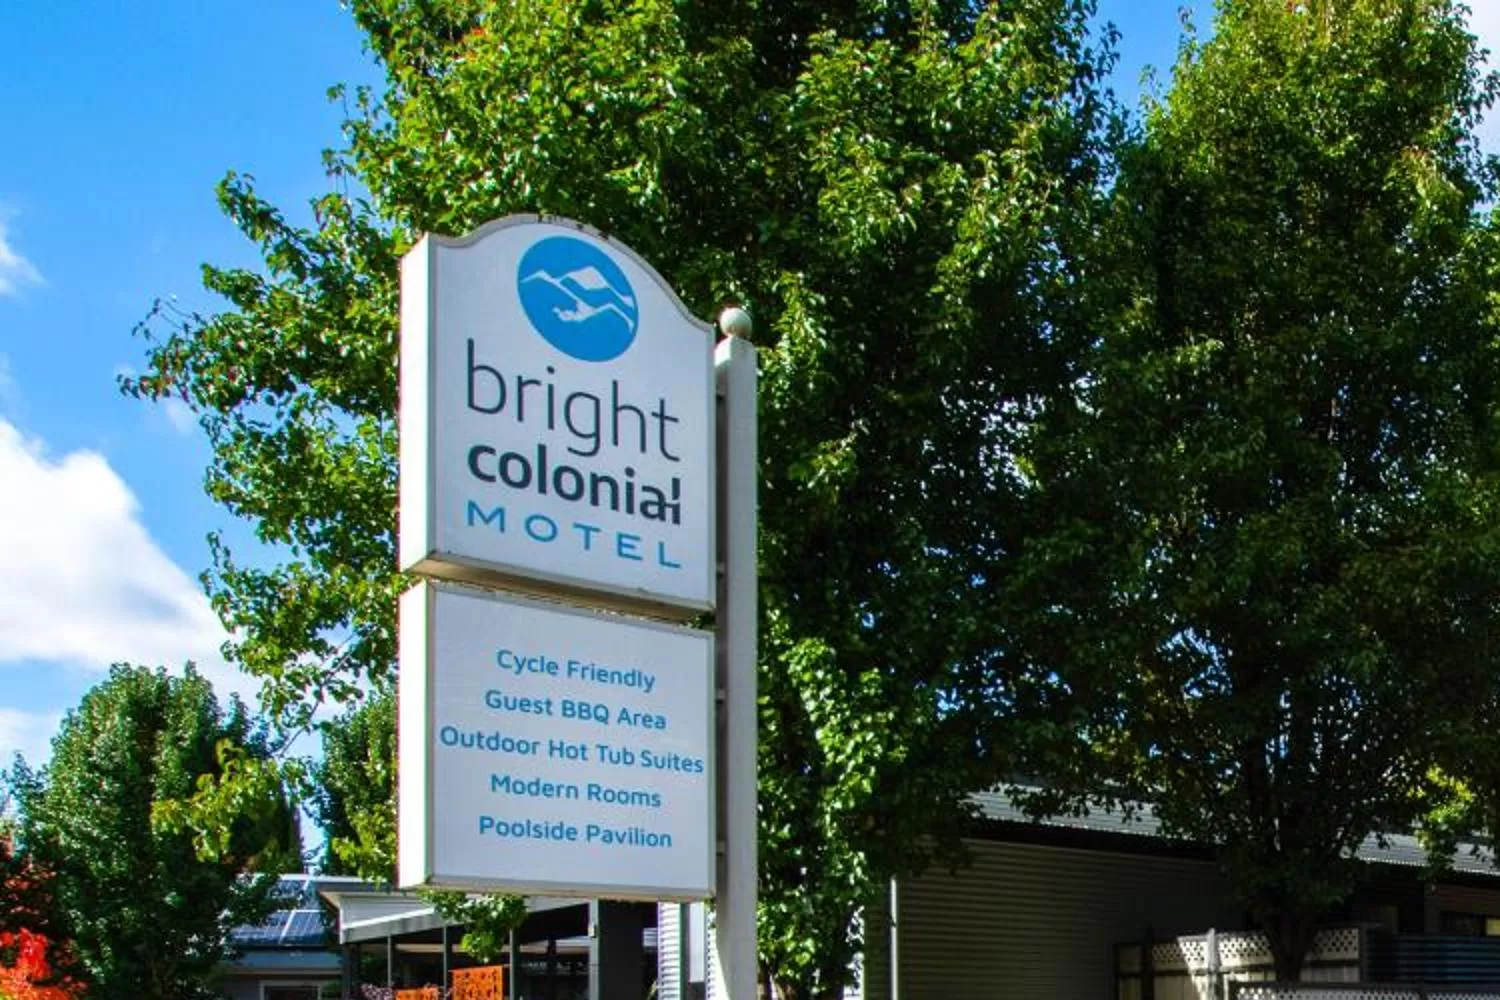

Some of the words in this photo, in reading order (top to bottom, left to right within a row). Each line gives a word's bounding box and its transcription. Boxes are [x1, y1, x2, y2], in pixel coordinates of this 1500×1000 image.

[466, 338, 681, 462] bright
[467, 443, 681, 526] colonial
[466, 500, 682, 569] MOTEL
[496, 649, 559, 676] Cycle
[567, 660, 656, 693] Friendly
[485, 689, 553, 717] Guest
[561, 699, 609, 725] BBQ
[617, 708, 667, 730] Area
[440, 726, 541, 756] Outdoor
[548, 739, 589, 762] Hot
[596, 745, 635, 766] Tub
[641, 751, 704, 774] Suites
[490, 773, 579, 800] Modern
[587, 783, 662, 808] Rooms
[479, 815, 578, 842] Poolside
[586, 824, 672, 848] Pavilion
